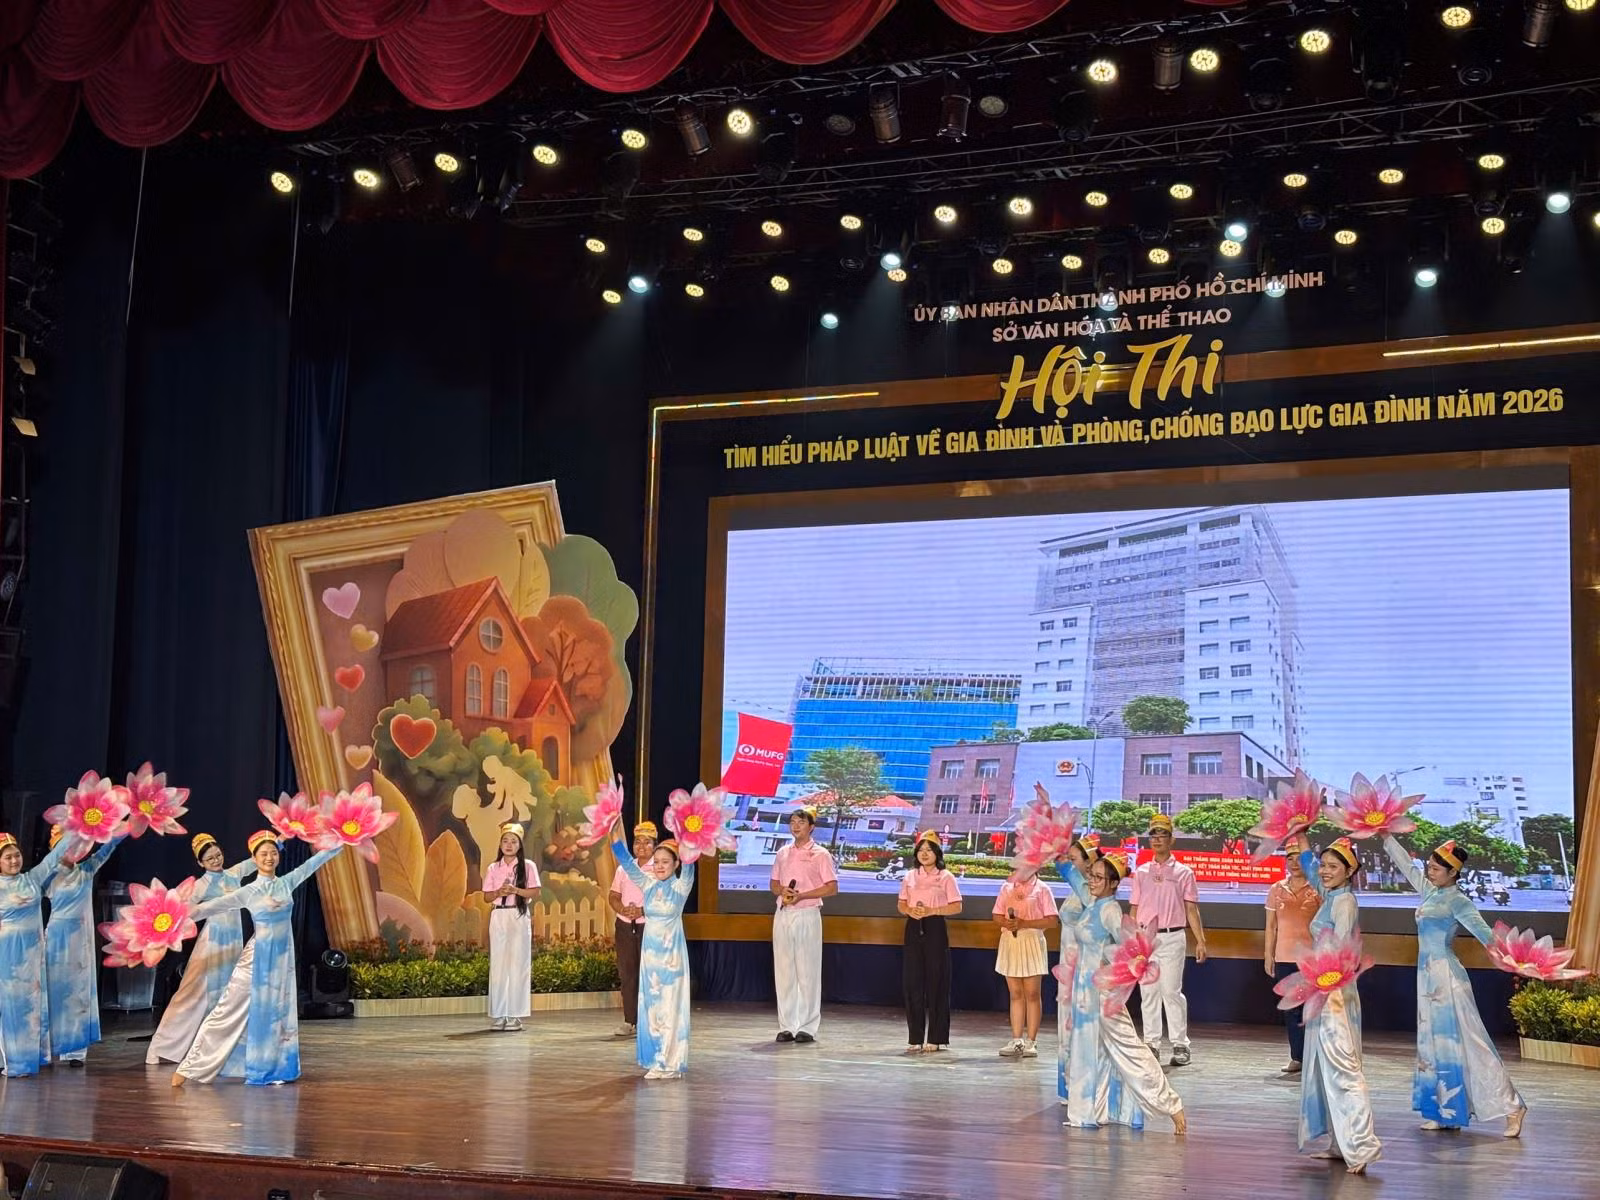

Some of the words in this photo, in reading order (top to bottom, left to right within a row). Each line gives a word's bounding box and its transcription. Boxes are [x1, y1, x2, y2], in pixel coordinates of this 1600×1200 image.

[914, 303, 938, 322] ỦY
[940, 303, 977, 321] BAN
[981, 297, 1033, 318] NHÂN
[1037, 292, 1077, 313] DÂN
[1081, 286, 1145, 310] THÀNH
[1150, 276, 1191, 303] PHỐ
[1196, 272, 1226, 298] HỒ
[1231, 272, 1267, 294] CHÍ
[992, 321, 1018, 343] SỞ
[1022, 322, 1058, 340] VĂN
[1064, 315, 1106, 337] HÓA
[1110, 312, 1133, 333] VÀ
[1137, 305, 1172, 329] THỂ
[1178, 308, 1232, 327] THAO
[995, 344, 1106, 419] Hội
[1127, 333, 1223, 409] Thi
[724, 445, 757, 469] TÌM
[762, 434, 803, 467] HIỂU
[808, 435, 859, 463] PHÁP
[864, 431, 909, 464] LUẬT
[916, 427, 941, 456] VỀ
[946, 430, 980, 454] GIA
[985, 424, 1035, 451] ĐÌNH
[1039, 419, 1067, 447] VÀ
[1230, 407, 1275, 438] BẠO
[1280, 403, 1323, 435] LỰC
[1328, 403, 1368, 427] GIA
[1374, 394, 1430, 424] ĐÌNH
[1437, 388, 1495, 419] NĂM
[1502, 388, 1564, 415] 2026
[755, 748, 784, 760] MUFG
